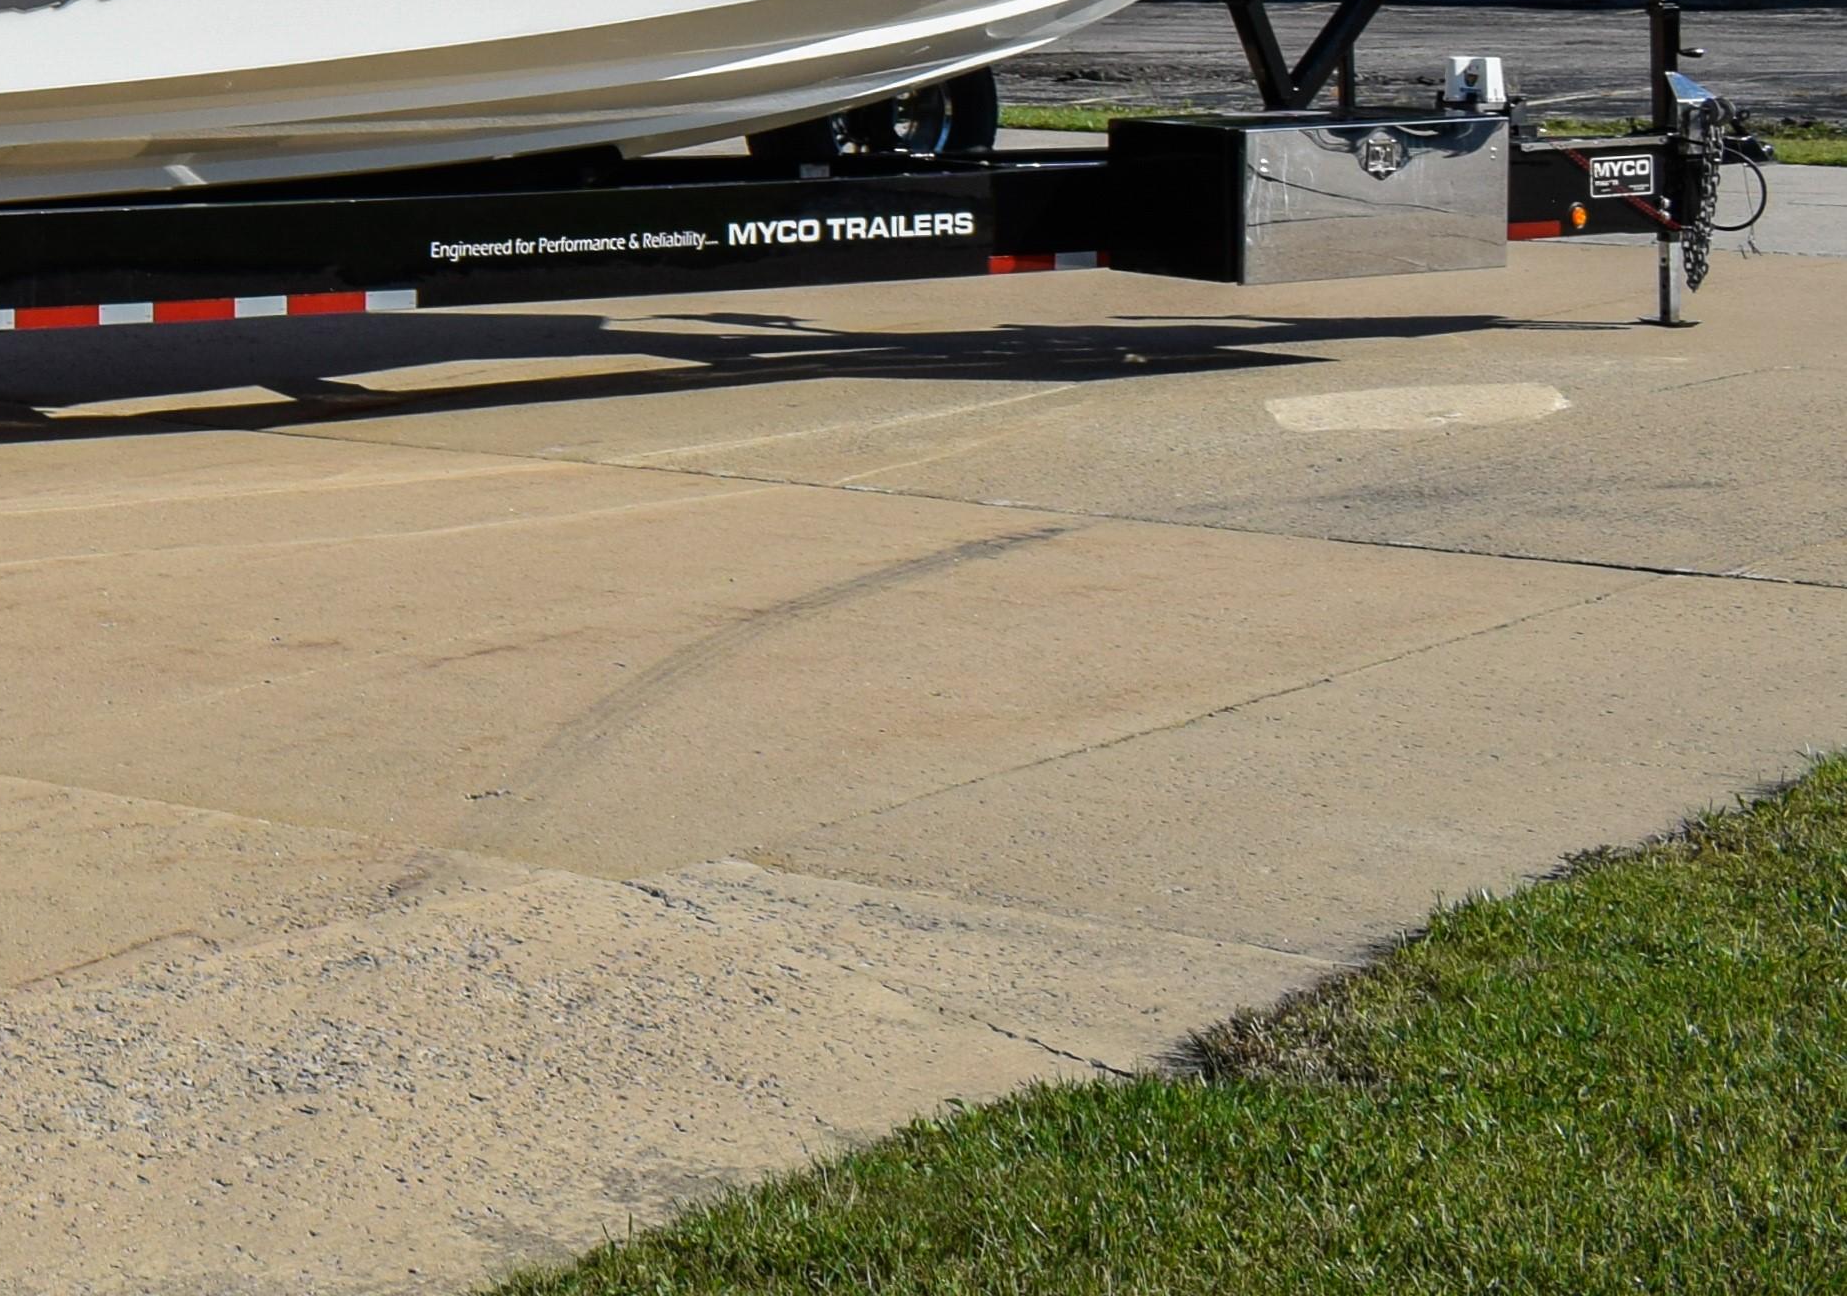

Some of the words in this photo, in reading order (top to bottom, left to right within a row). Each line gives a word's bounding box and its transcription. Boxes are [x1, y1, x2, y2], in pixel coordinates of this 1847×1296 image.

[1593, 159, 1650, 178] MYCO
[430, 241, 512, 262] Engineered
[515, 238, 536, 255] for
[538, 233, 626, 254] Performance
[628, 233, 640, 249] &
[728, 219, 820, 246] MYCO
[826, 212, 975, 241] TRAILERS
